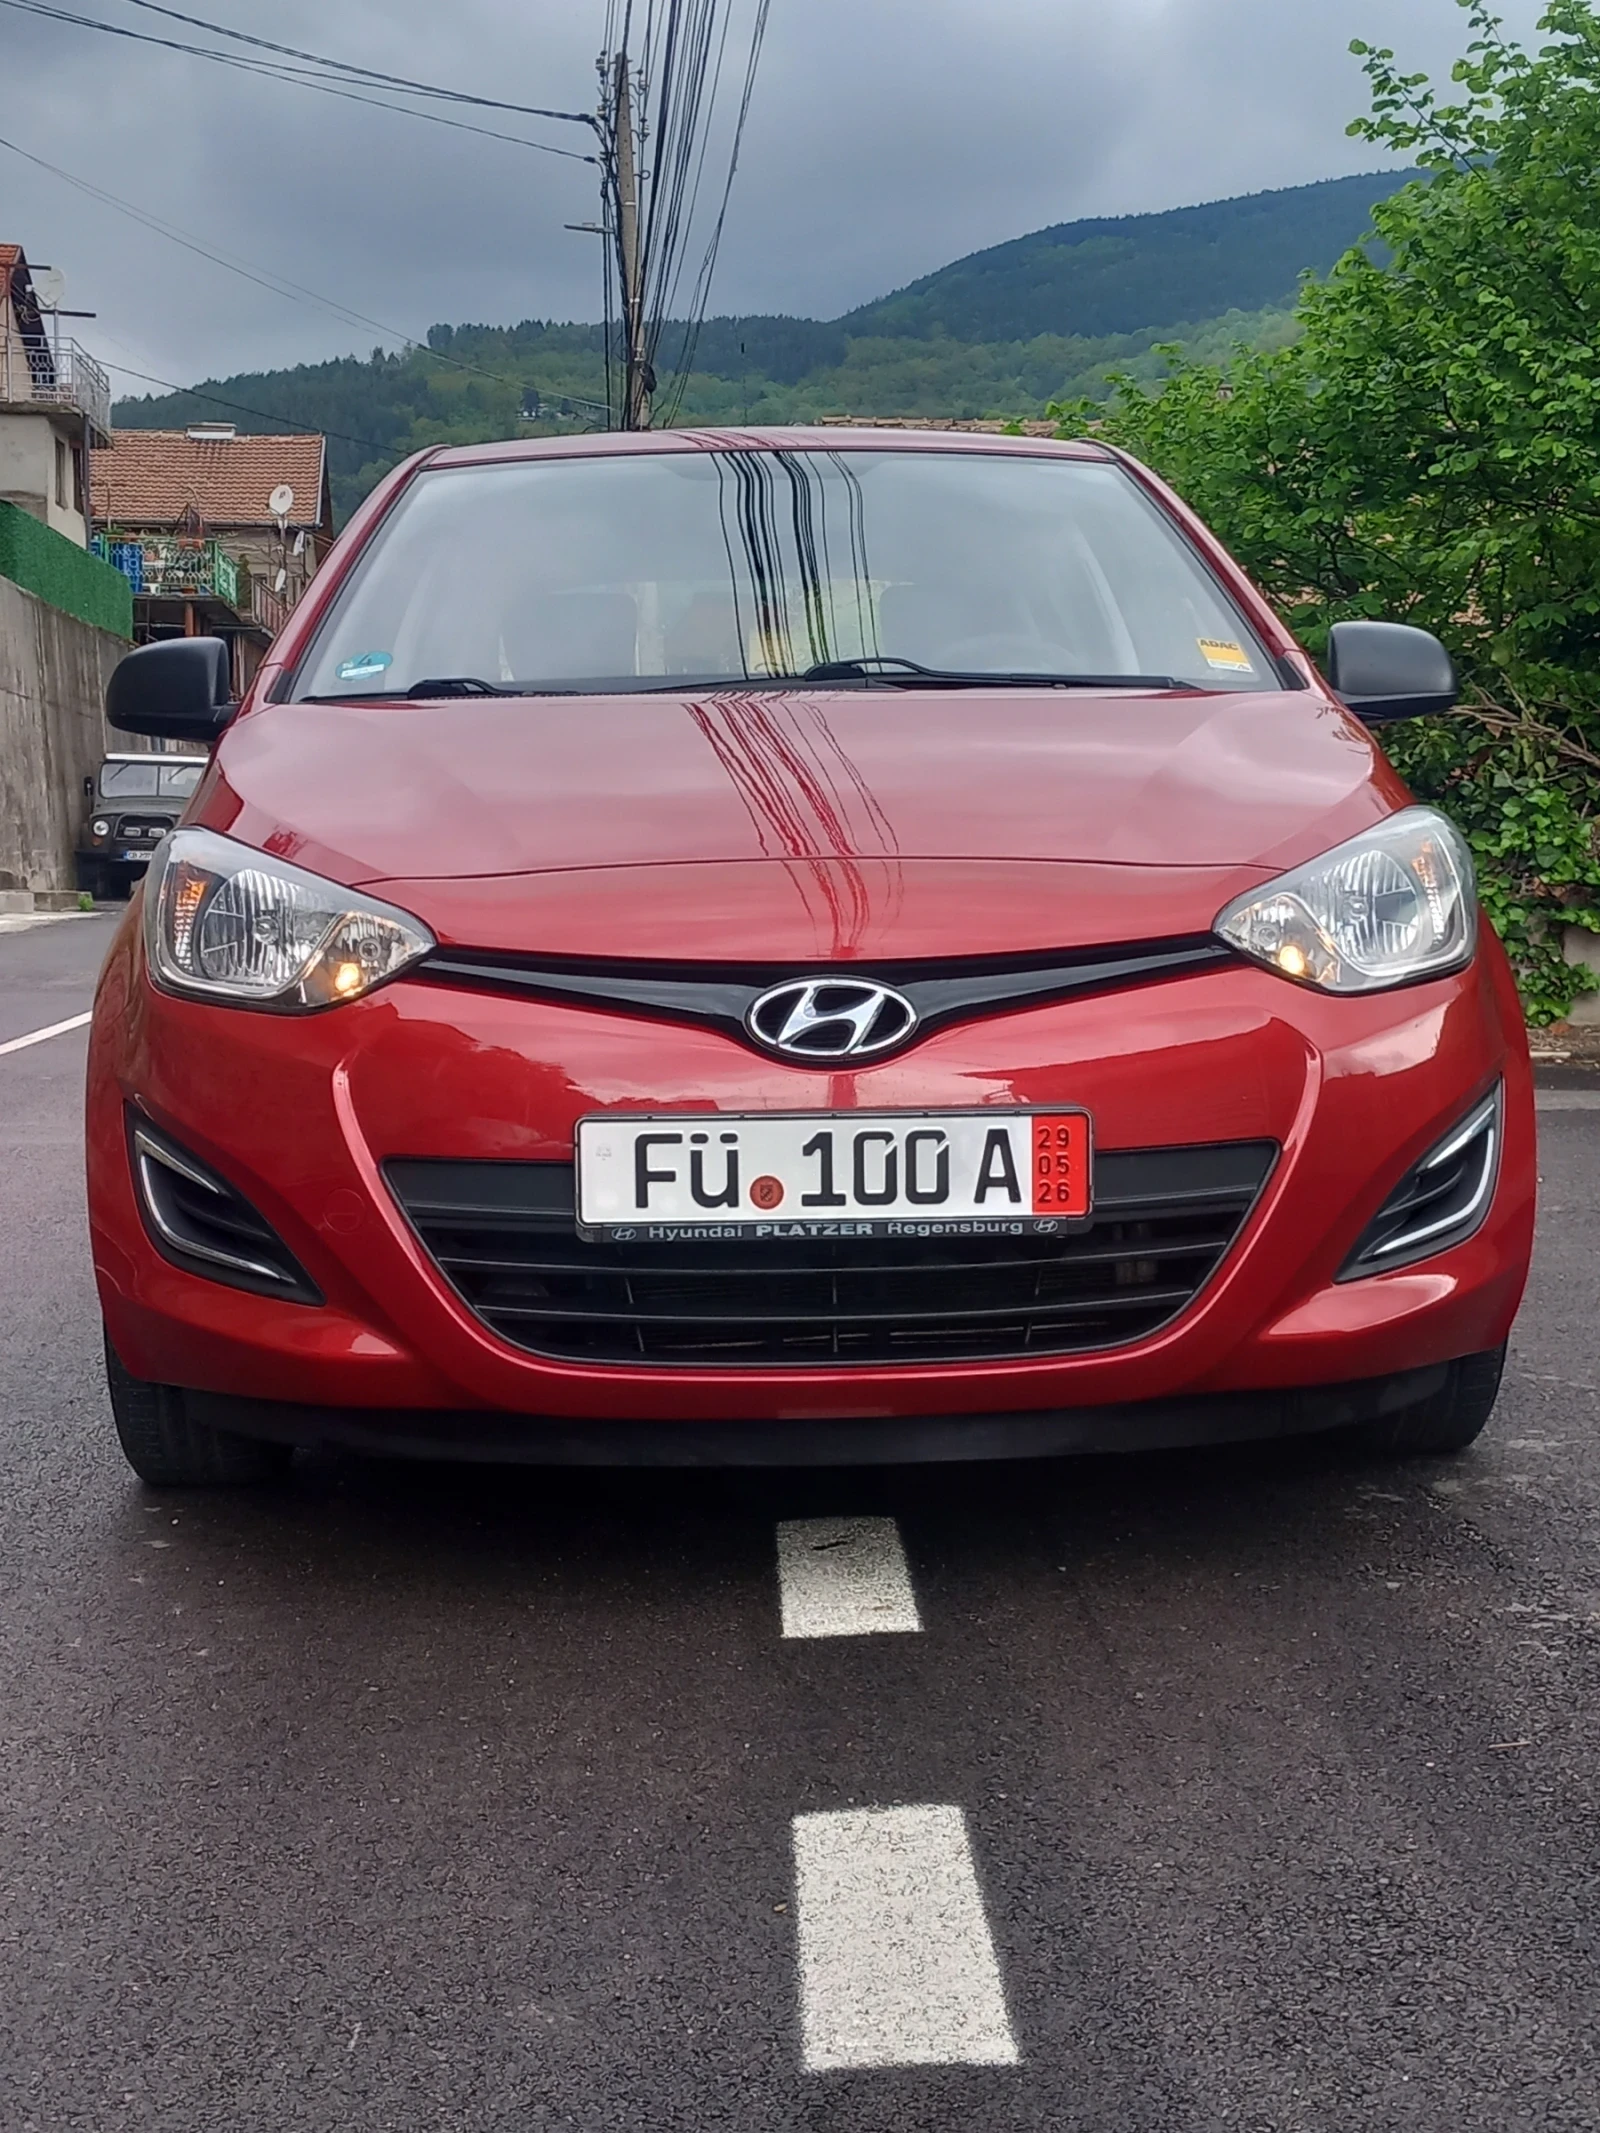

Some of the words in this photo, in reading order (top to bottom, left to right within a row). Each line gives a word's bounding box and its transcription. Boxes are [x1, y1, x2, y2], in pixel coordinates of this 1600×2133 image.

[1200, 639, 1239, 651] ADAC
[1037, 1126, 1070, 1149] 29
[634, 1133, 740, 1208] FÜ
[801, 1130, 951, 1206] 100
[973, 1128, 1022, 1204] A
[1037, 1153, 1070, 1175] 05
[1037, 1180, 1070, 1204] 26
[649, 1225, 743, 1241] Hyundai
[755, 1222, 873, 1238] PLATZER
[887, 1221, 1023, 1236] Regensburg
